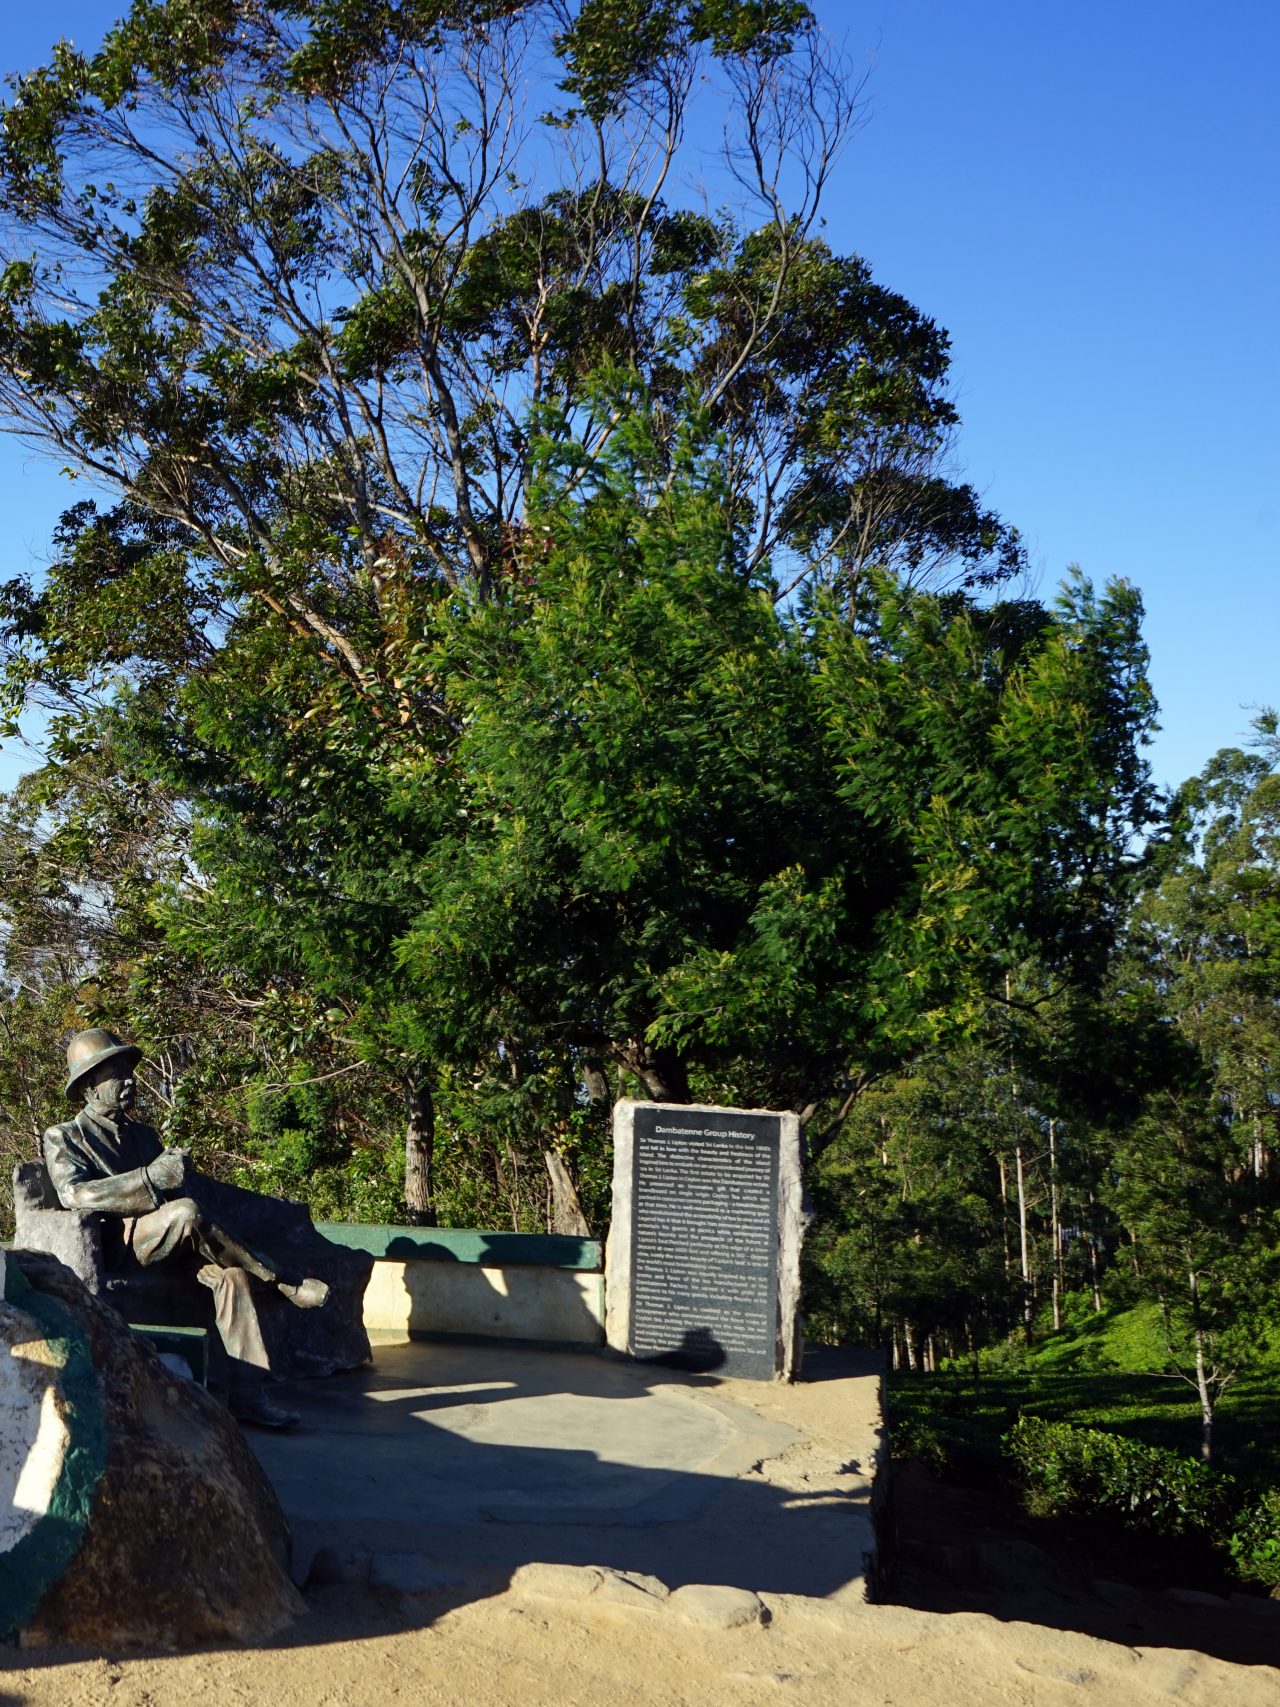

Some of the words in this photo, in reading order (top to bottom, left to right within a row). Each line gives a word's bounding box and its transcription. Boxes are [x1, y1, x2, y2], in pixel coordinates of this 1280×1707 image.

[655, 1125, 703, 1136] Dambatenne
[704, 1129, 727, 1138] Group
[728, 1130, 756, 1140] History
